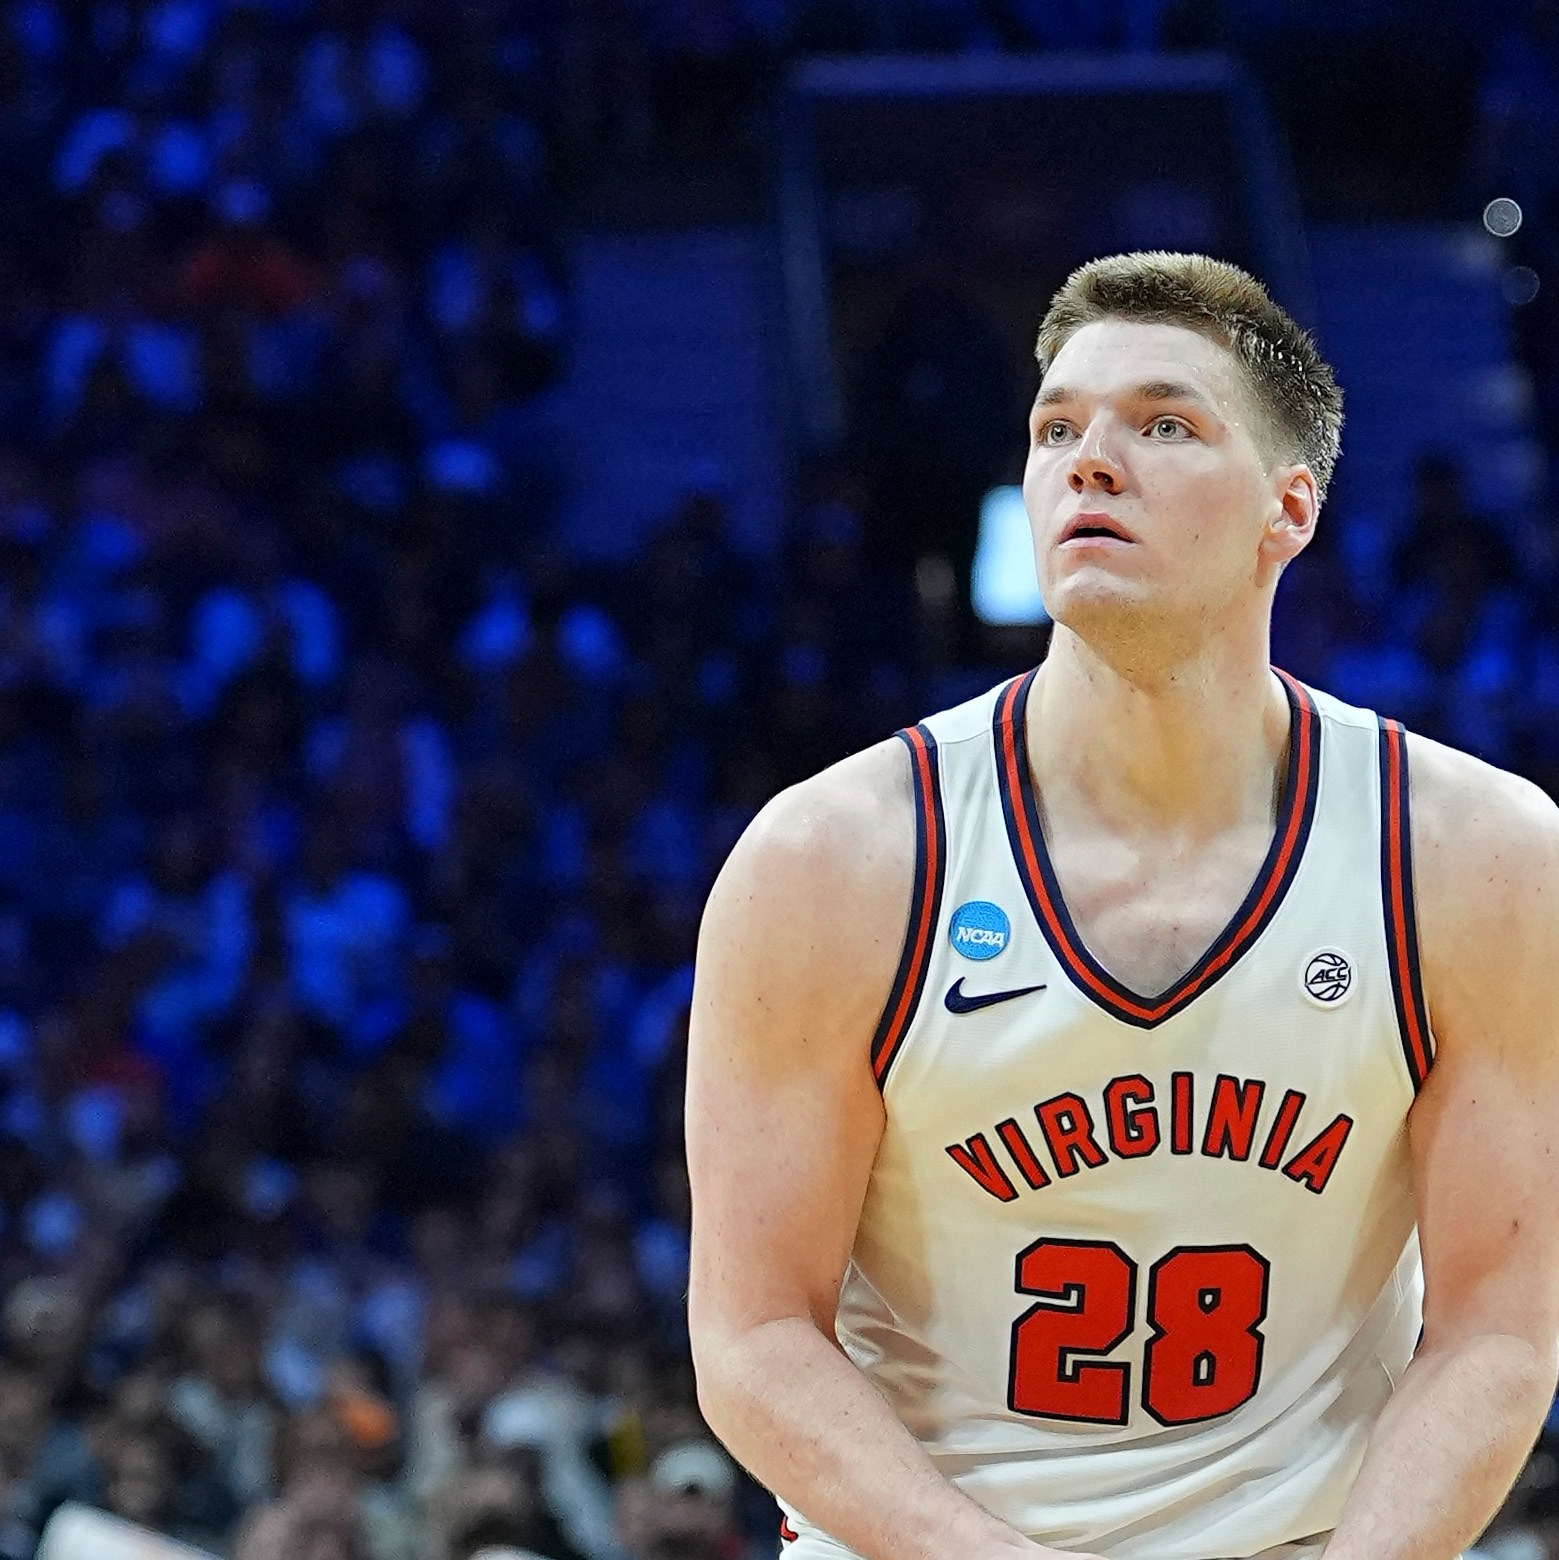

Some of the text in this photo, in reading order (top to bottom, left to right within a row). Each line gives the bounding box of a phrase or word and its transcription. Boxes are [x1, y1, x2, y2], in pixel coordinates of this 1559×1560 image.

[956, 926, 1005, 947] NCAA
[1310, 967, 1348, 984] ACC
[945, 1072, 1353, 1202] VIRGINIA
[1007, 1237, 1270, 1426] 28
